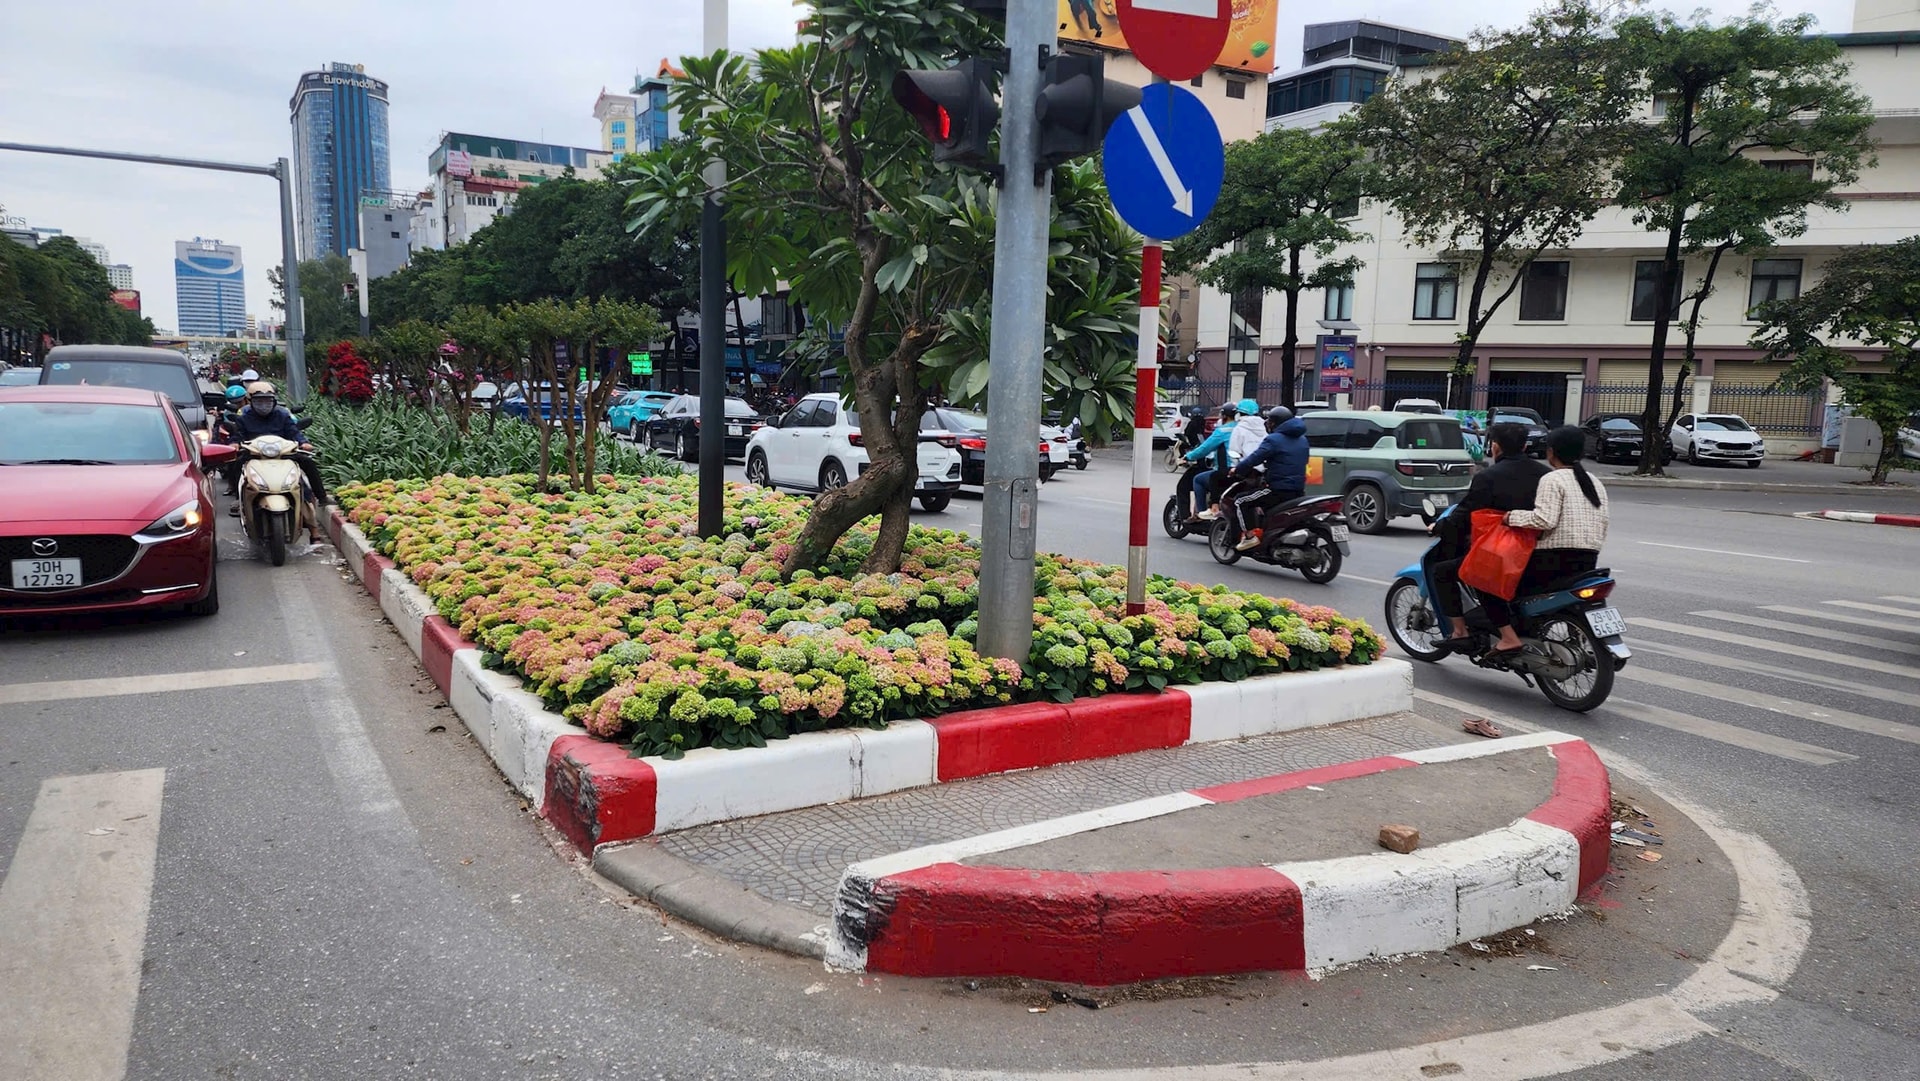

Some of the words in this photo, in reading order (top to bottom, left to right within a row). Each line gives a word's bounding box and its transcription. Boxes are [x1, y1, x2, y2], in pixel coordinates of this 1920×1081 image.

[31, 561, 62, 574] 30H
[22, 573, 75, 587] 127.92
[1593, 620, 1626, 636] 546.39
